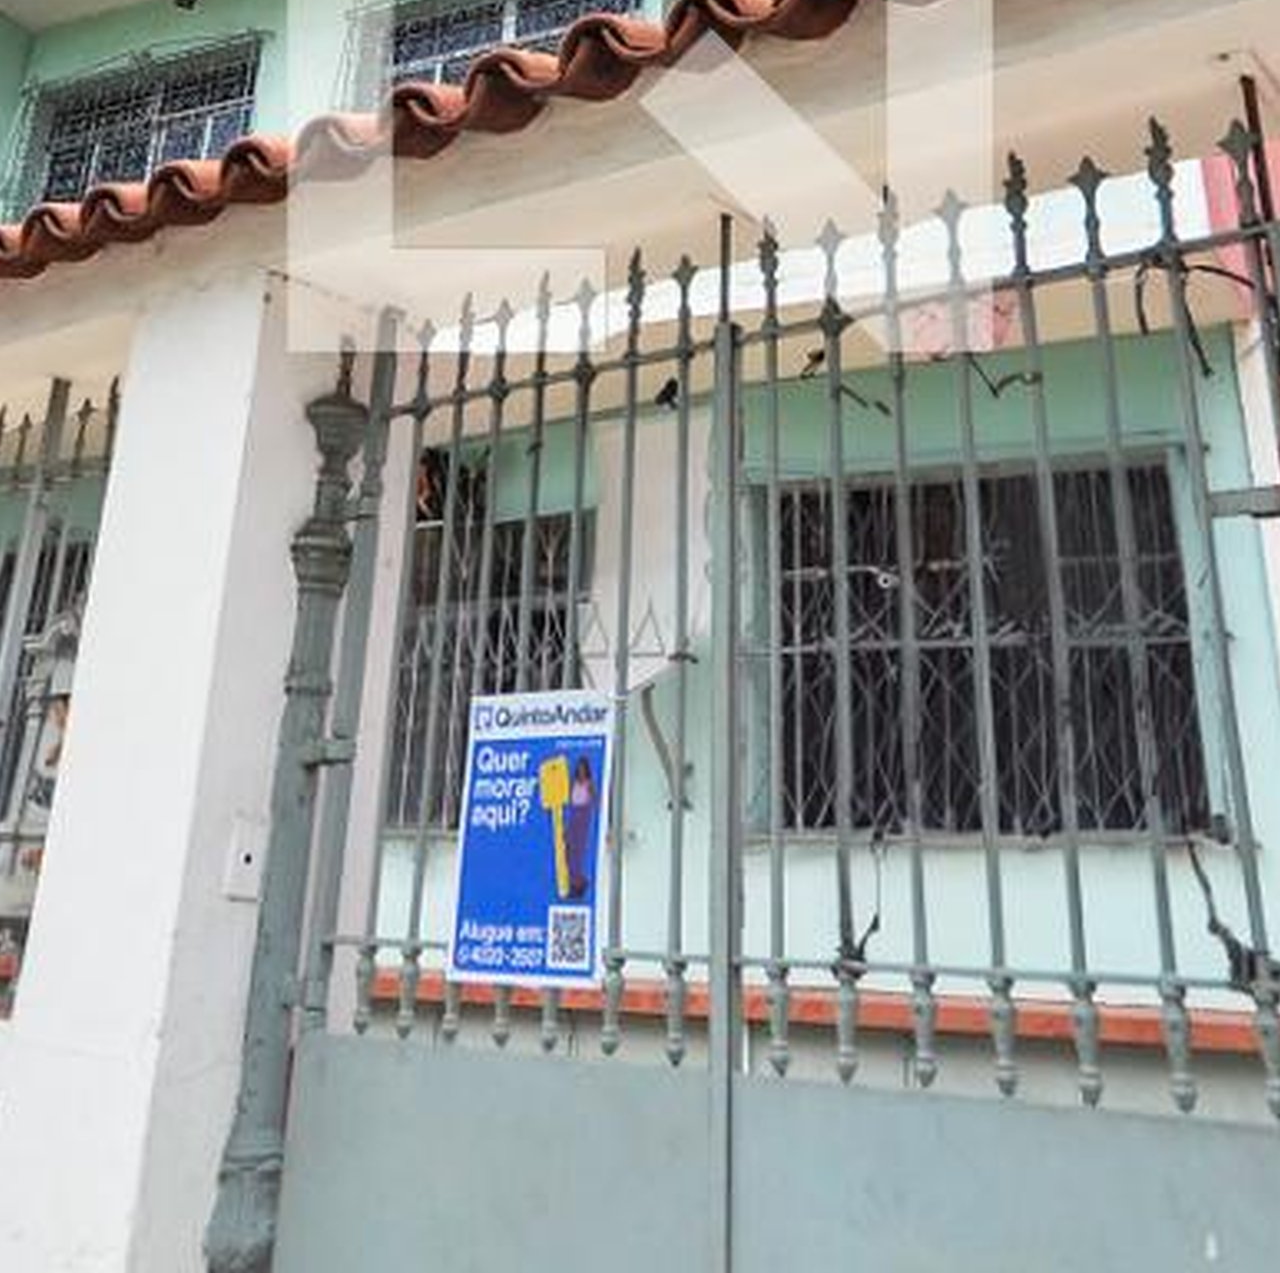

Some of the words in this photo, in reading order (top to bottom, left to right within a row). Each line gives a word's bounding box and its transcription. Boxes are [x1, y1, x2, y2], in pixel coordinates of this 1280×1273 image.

[495, 705, 607, 729] QuintoAndar
[477, 746, 529, 773] Quer
[473, 777, 538, 799] morar
[472, 798, 531, 831] aqui?
